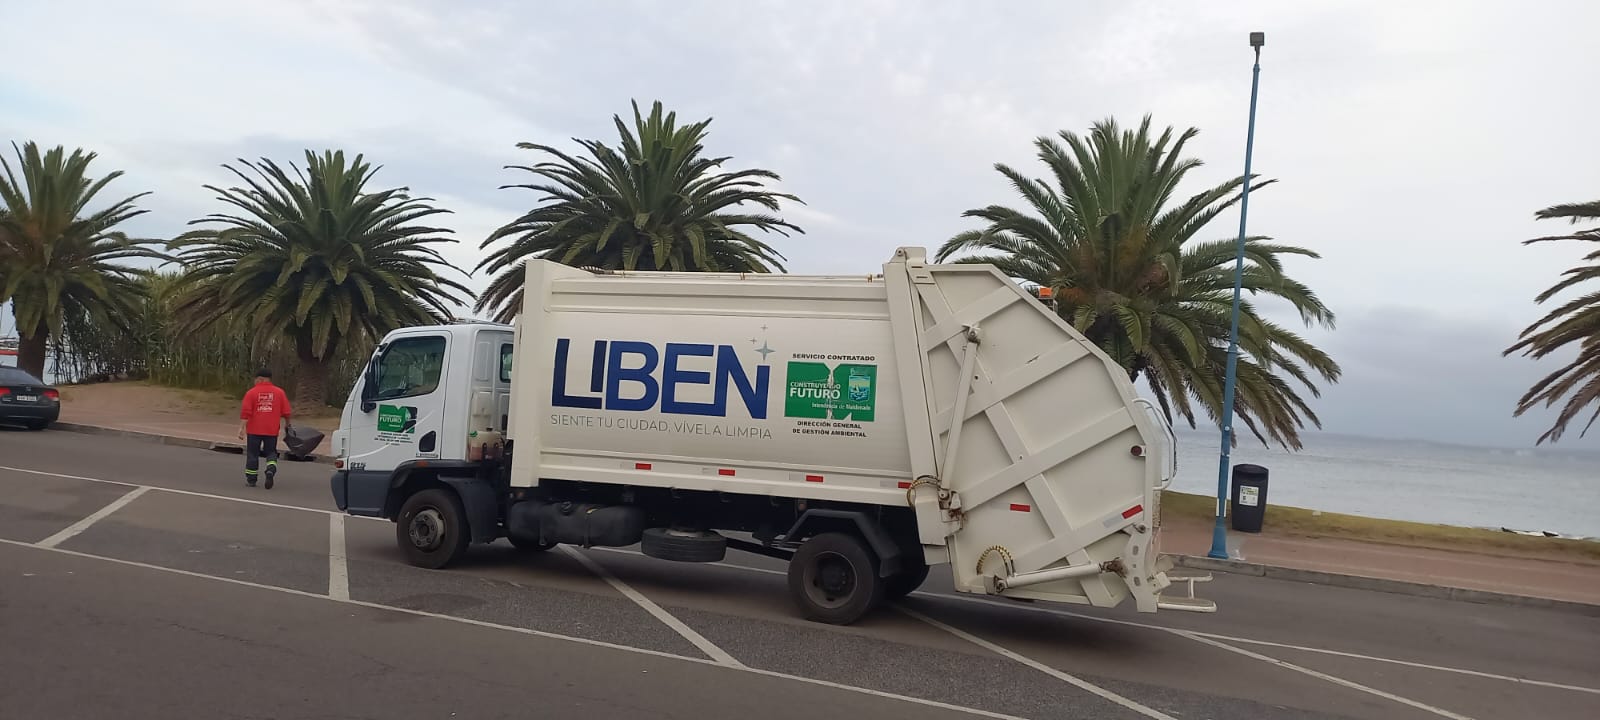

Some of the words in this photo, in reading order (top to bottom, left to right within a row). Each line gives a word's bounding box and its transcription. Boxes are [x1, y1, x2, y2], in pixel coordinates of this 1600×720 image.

[551, 338, 771, 420] LIBEN
[789, 388, 841, 399] FUTURO
[551, 414, 593, 427] SIENTE
[599, 417, 613, 428] TU
[617, 418, 671, 433] CIUDAD,
[674, 420, 722, 436] VÍVELA
[725, 425, 773, 440] LIMPIA
[797, 420, 831, 428] DIRECCIÓN
